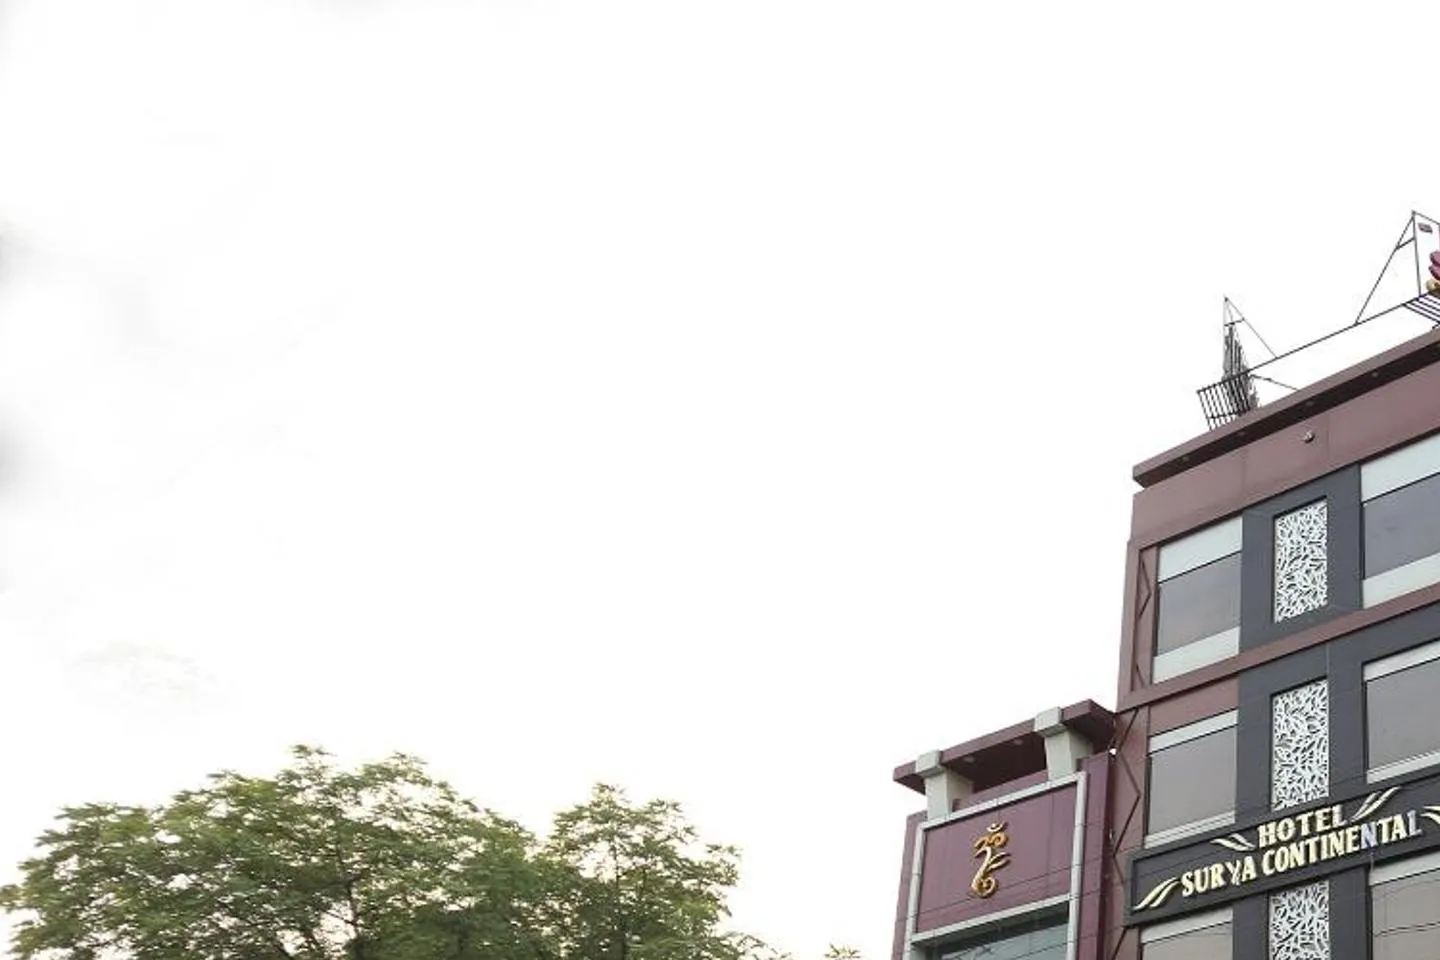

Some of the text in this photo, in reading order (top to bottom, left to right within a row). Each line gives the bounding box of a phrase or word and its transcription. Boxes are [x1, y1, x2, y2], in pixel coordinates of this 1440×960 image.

[1180, 807, 1425, 899] SURYA CONTINENTAL
[1257, 803, 1349, 850] HOTEL
